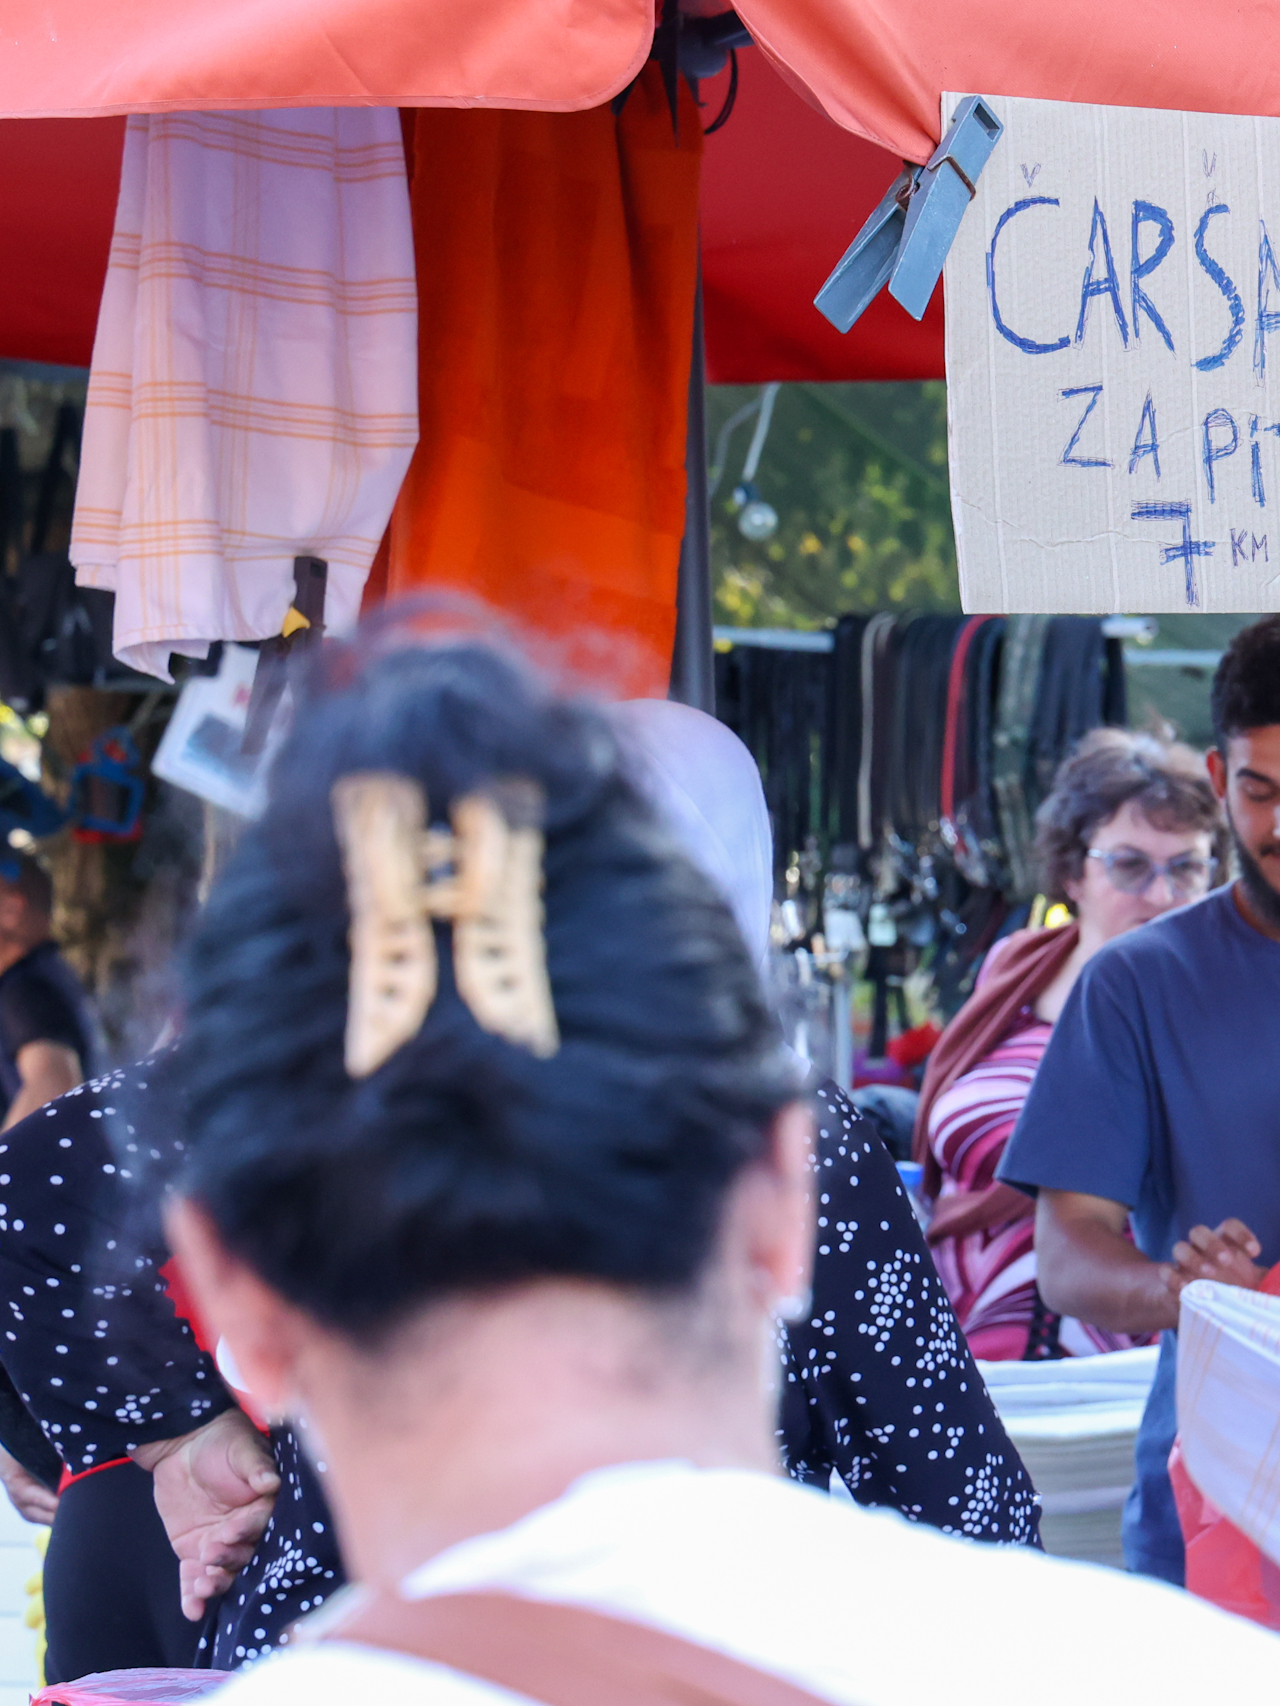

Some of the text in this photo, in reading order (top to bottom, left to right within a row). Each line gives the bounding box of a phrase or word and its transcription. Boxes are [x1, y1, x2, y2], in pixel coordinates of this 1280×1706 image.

[1056, 381, 1162, 482] ZA
[1130, 499, 1270, 607] 7 KM
